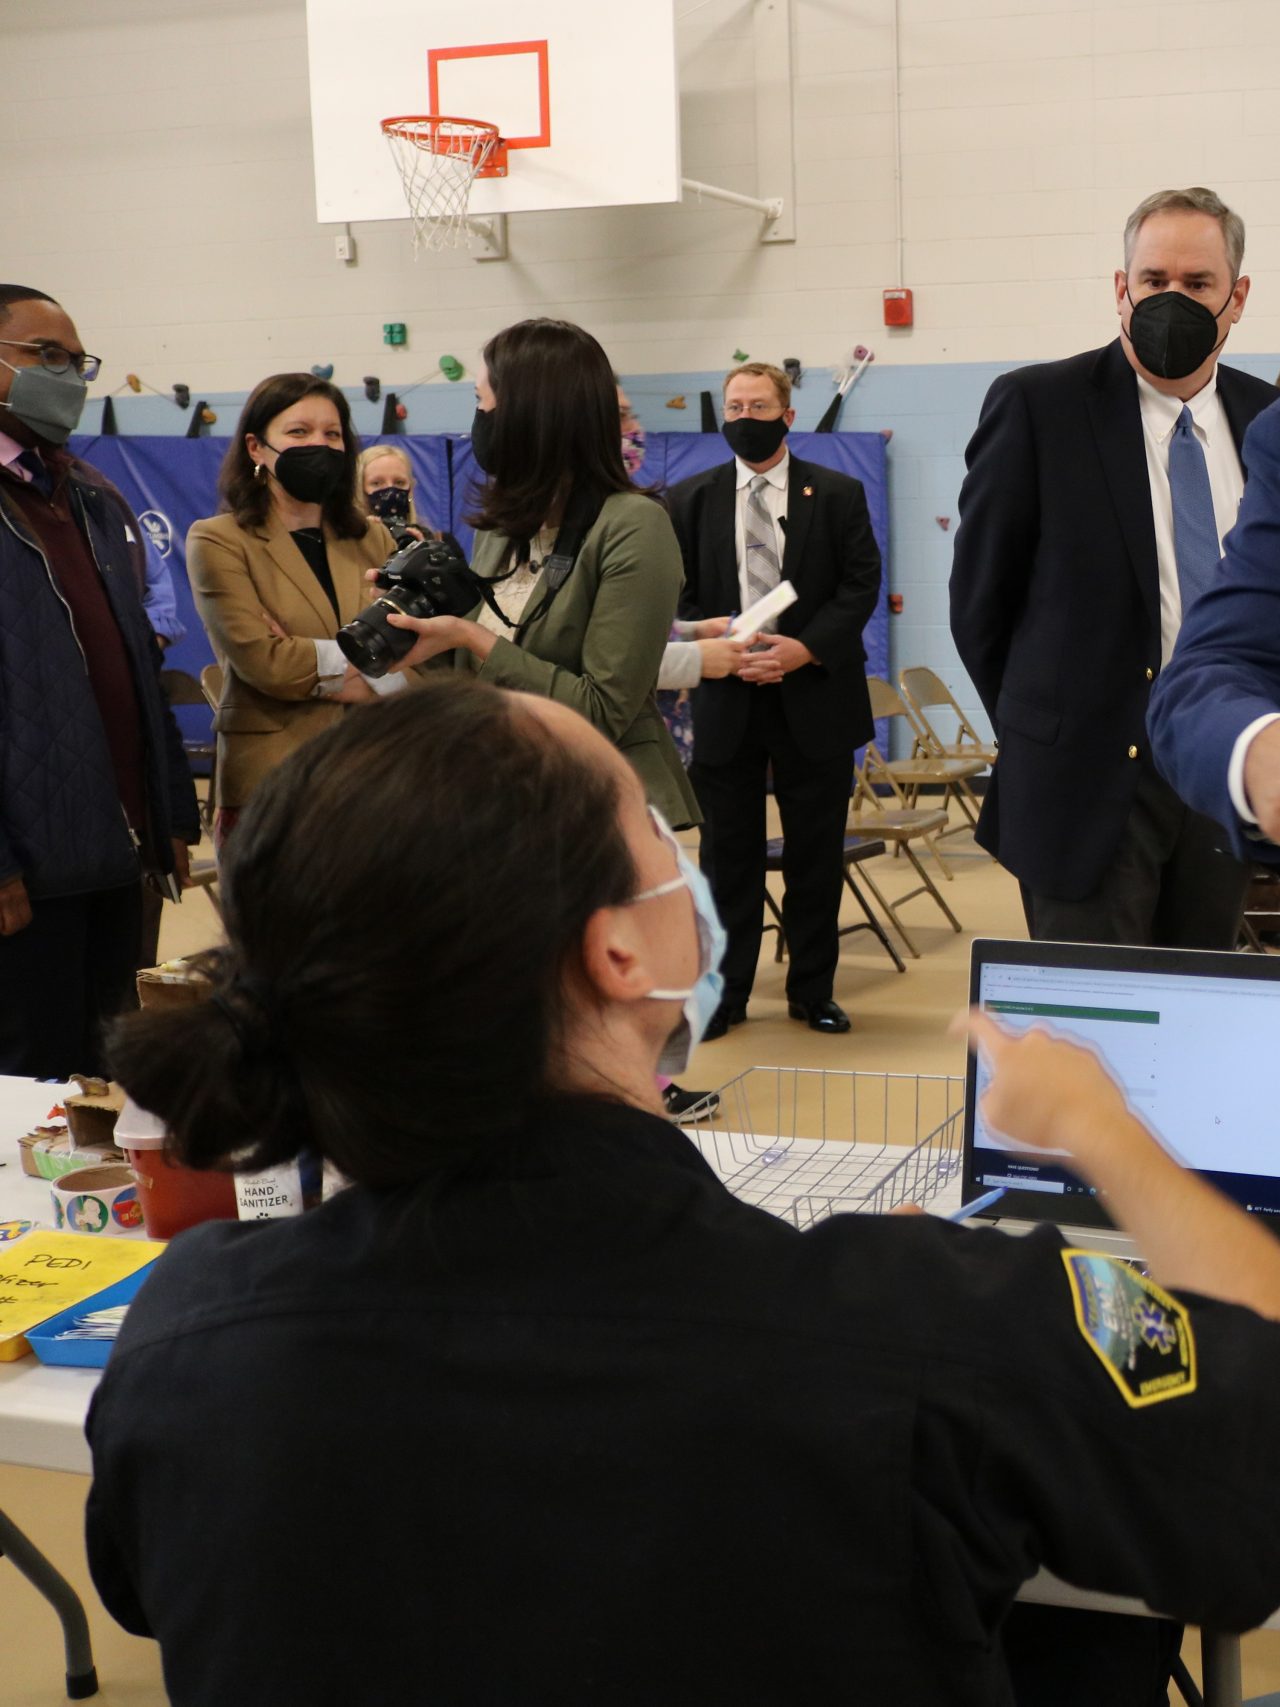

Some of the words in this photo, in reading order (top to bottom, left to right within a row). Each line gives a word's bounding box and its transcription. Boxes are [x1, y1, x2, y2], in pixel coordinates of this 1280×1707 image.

[244, 1186, 275, 1197] HAND
[24, 1254, 92, 1270] PEDI
[1094, 1276, 1119, 1333] EMT
